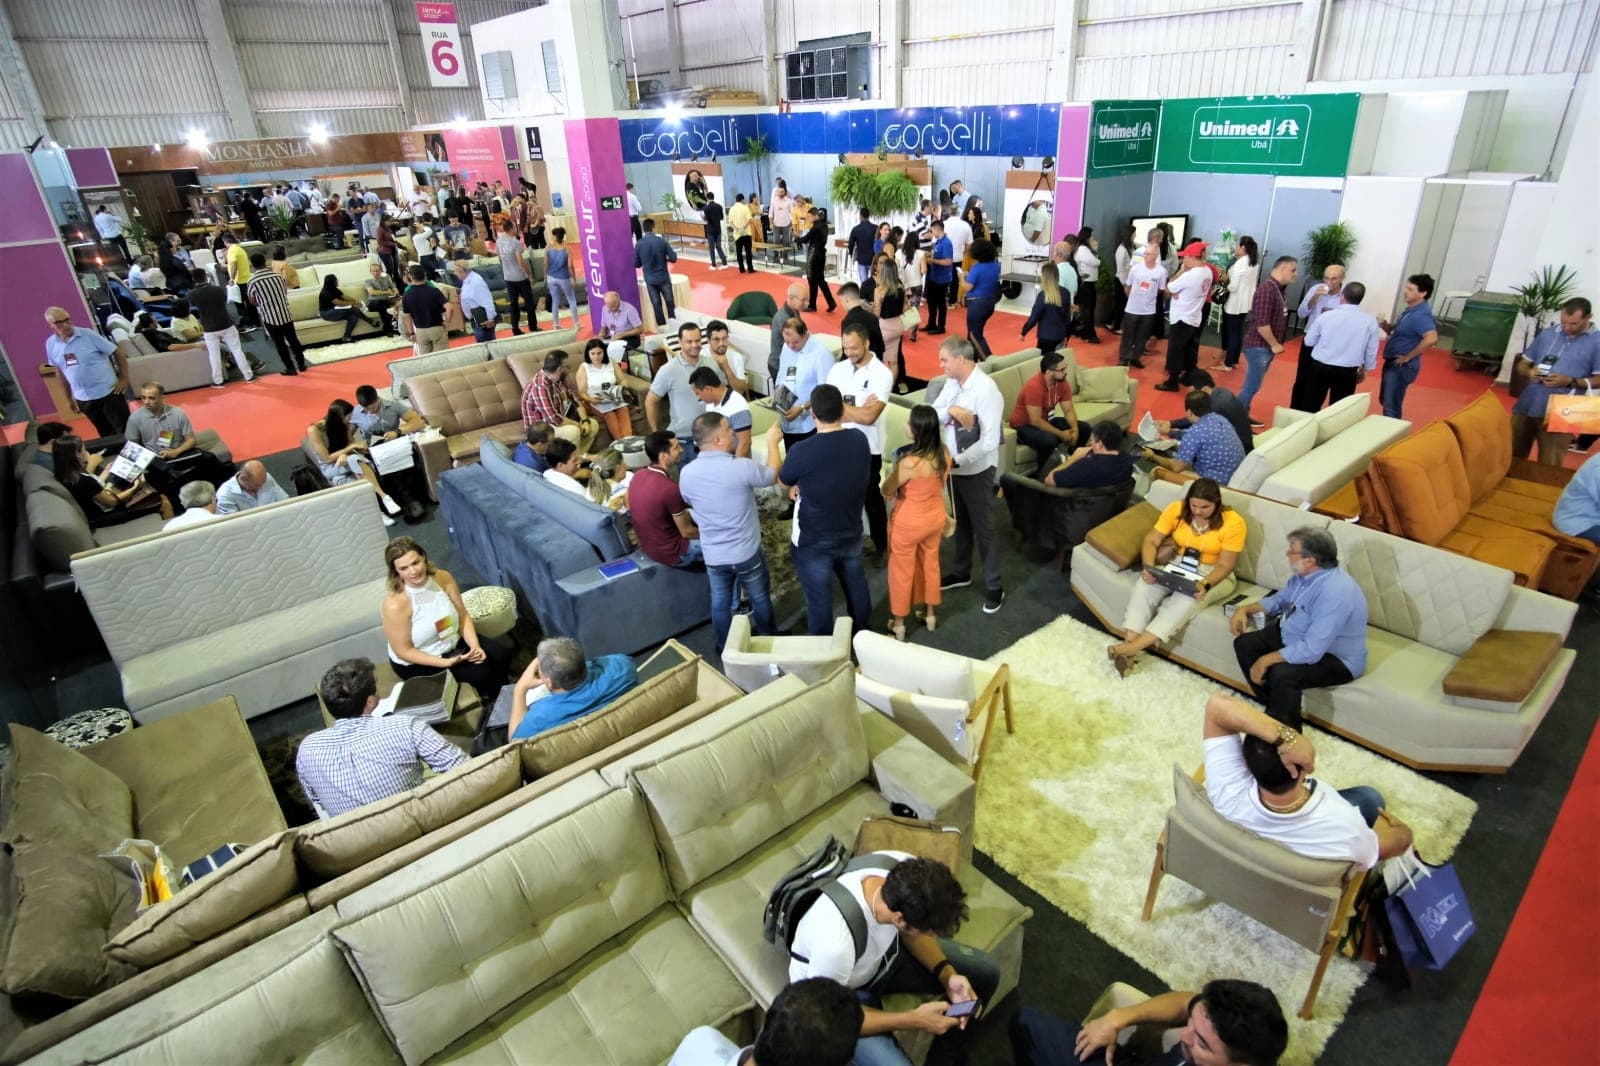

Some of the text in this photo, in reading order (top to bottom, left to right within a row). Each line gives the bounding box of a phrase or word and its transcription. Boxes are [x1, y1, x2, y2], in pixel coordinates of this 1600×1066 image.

[432, 40, 459, 76] 6
[1099, 122, 1139, 140] Unimed
[1200, 120, 1271, 136] Unimed
[205, 141, 318, 161] MONTANHA
[580, 166, 591, 202] 2020
